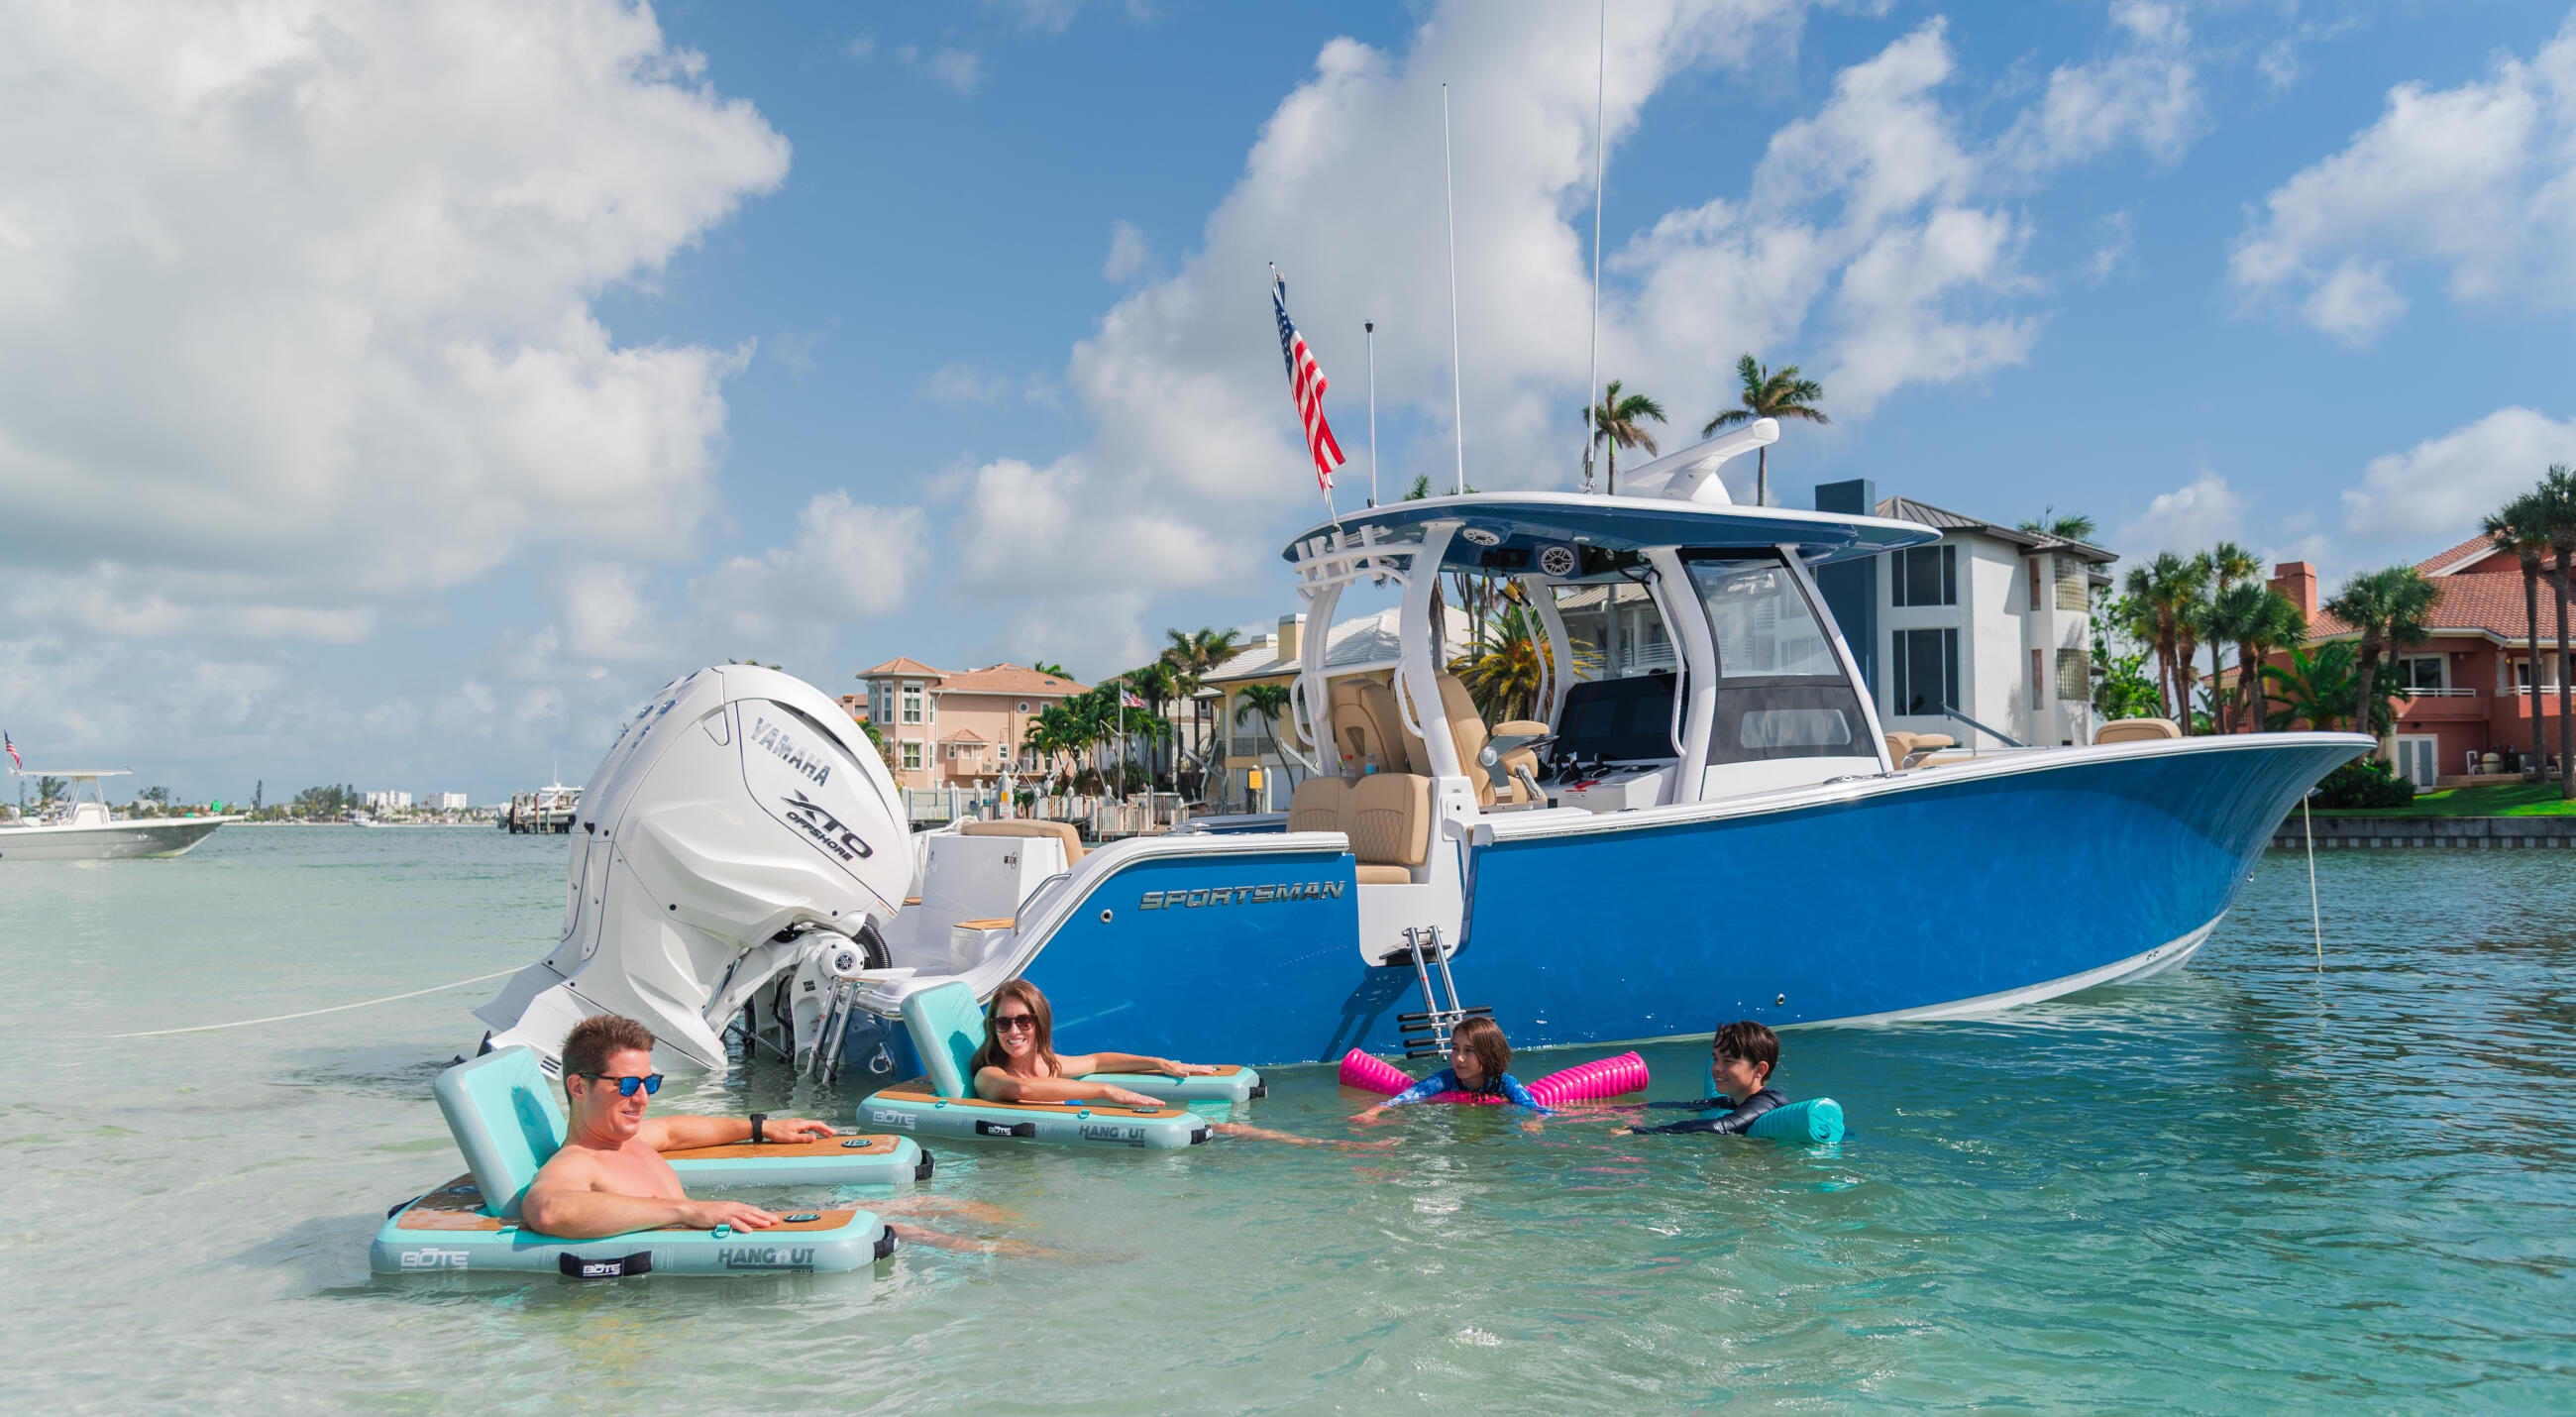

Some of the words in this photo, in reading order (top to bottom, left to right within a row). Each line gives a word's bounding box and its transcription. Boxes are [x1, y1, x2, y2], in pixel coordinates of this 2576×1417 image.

[751, 716, 831, 788] YAMAHA
[780, 788, 874, 860] XTO
[786, 811, 854, 862] OFFSHORE
[1139, 880, 1346, 911] SPORTSMAN
